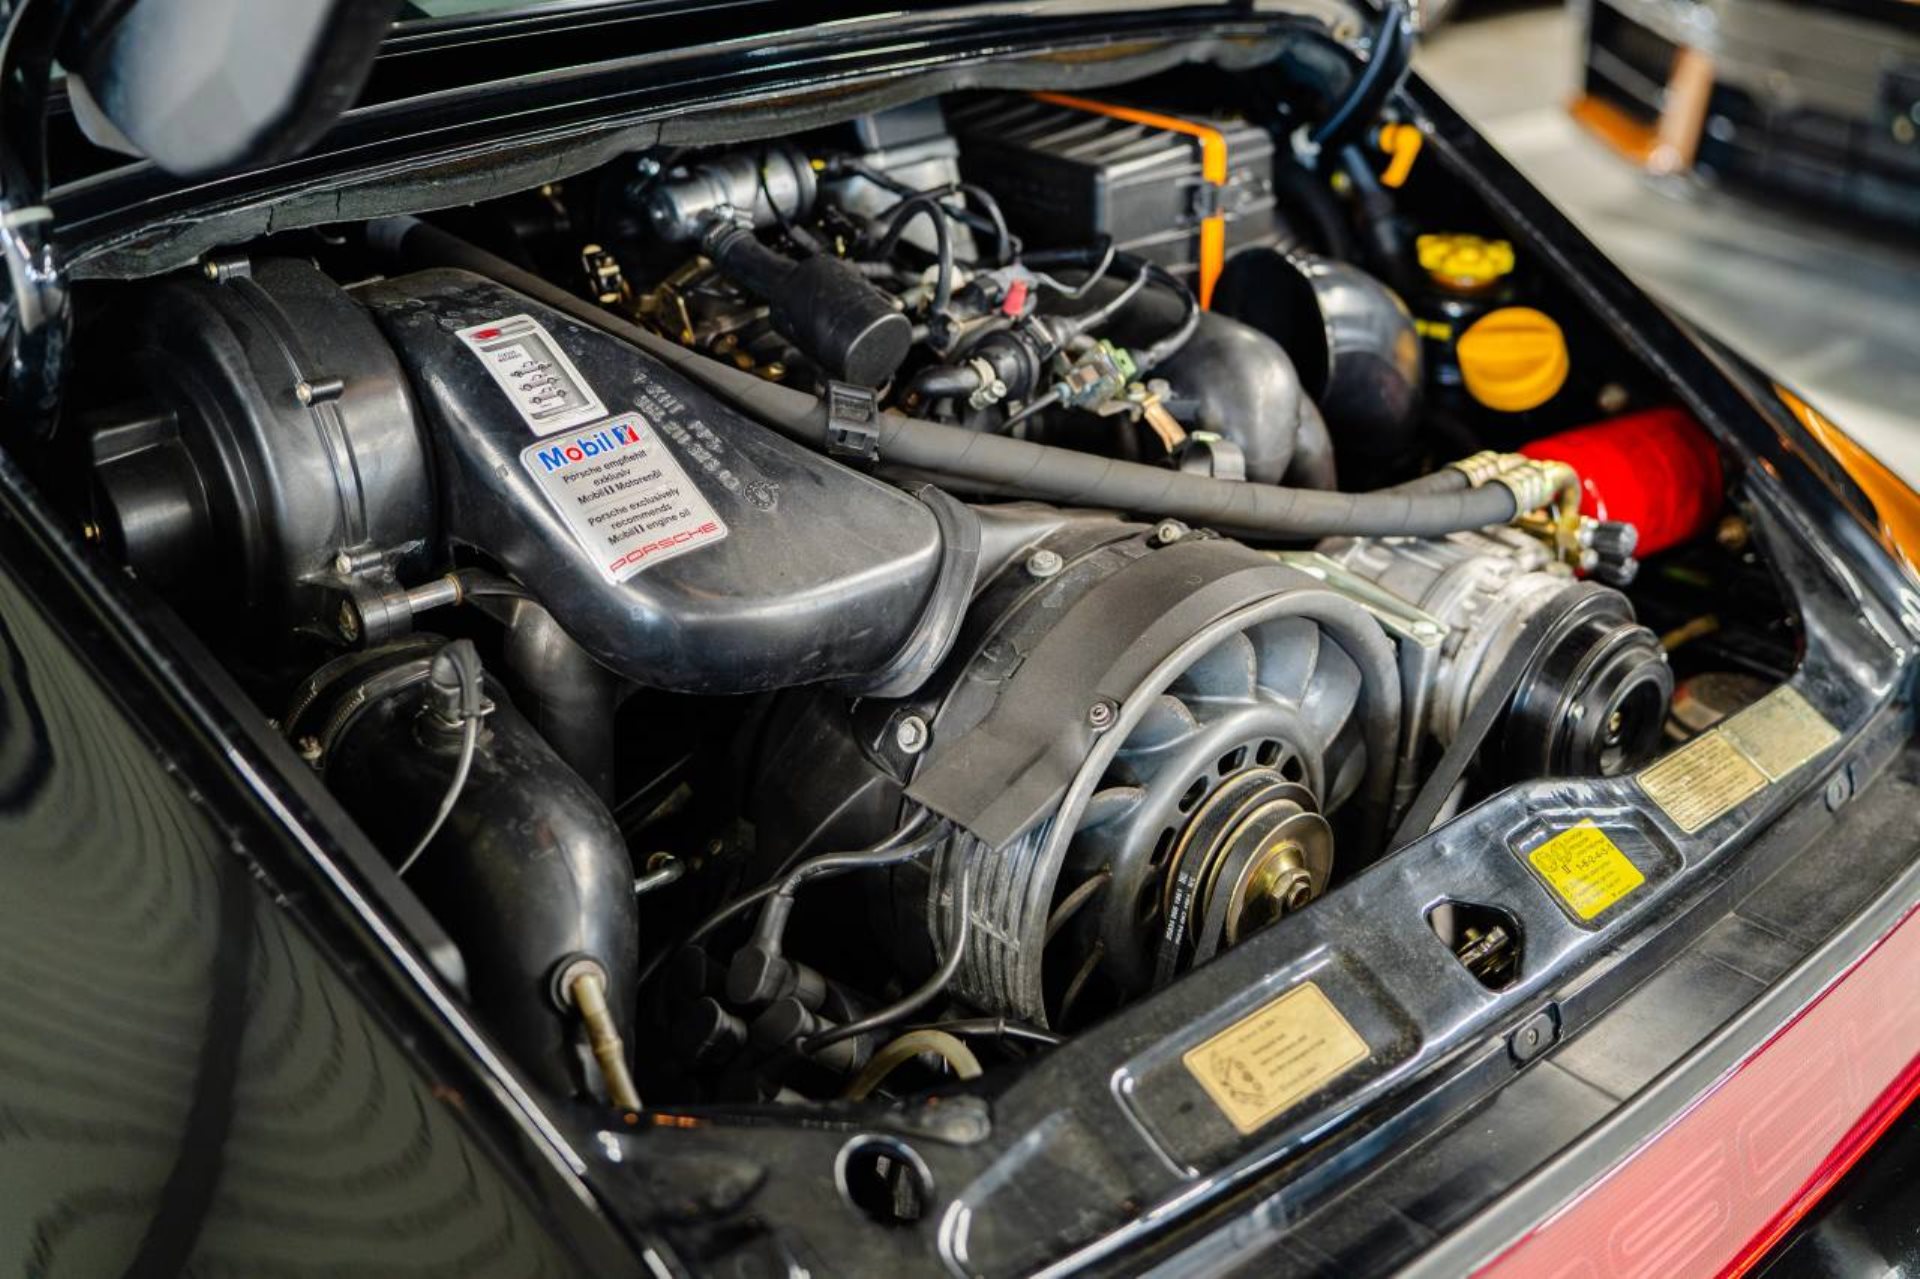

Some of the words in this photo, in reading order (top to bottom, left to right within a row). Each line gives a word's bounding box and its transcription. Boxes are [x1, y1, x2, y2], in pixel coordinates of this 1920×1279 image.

[538, 431, 615, 471] Mobil
[562, 465, 602, 484] Porsche
[603, 449, 647, 470] empfiehlt
[593, 468, 631, 486] exklusiv
[615, 468, 662, 491] Motorenöl
[588, 505, 629, 526] Porsche
[629, 487, 680, 510] exclusively
[611, 503, 673, 530] recommends
[646, 512, 678, 531] engine
[678, 508, 691, 520] oil
[609, 520, 719, 573] PORSCHE
